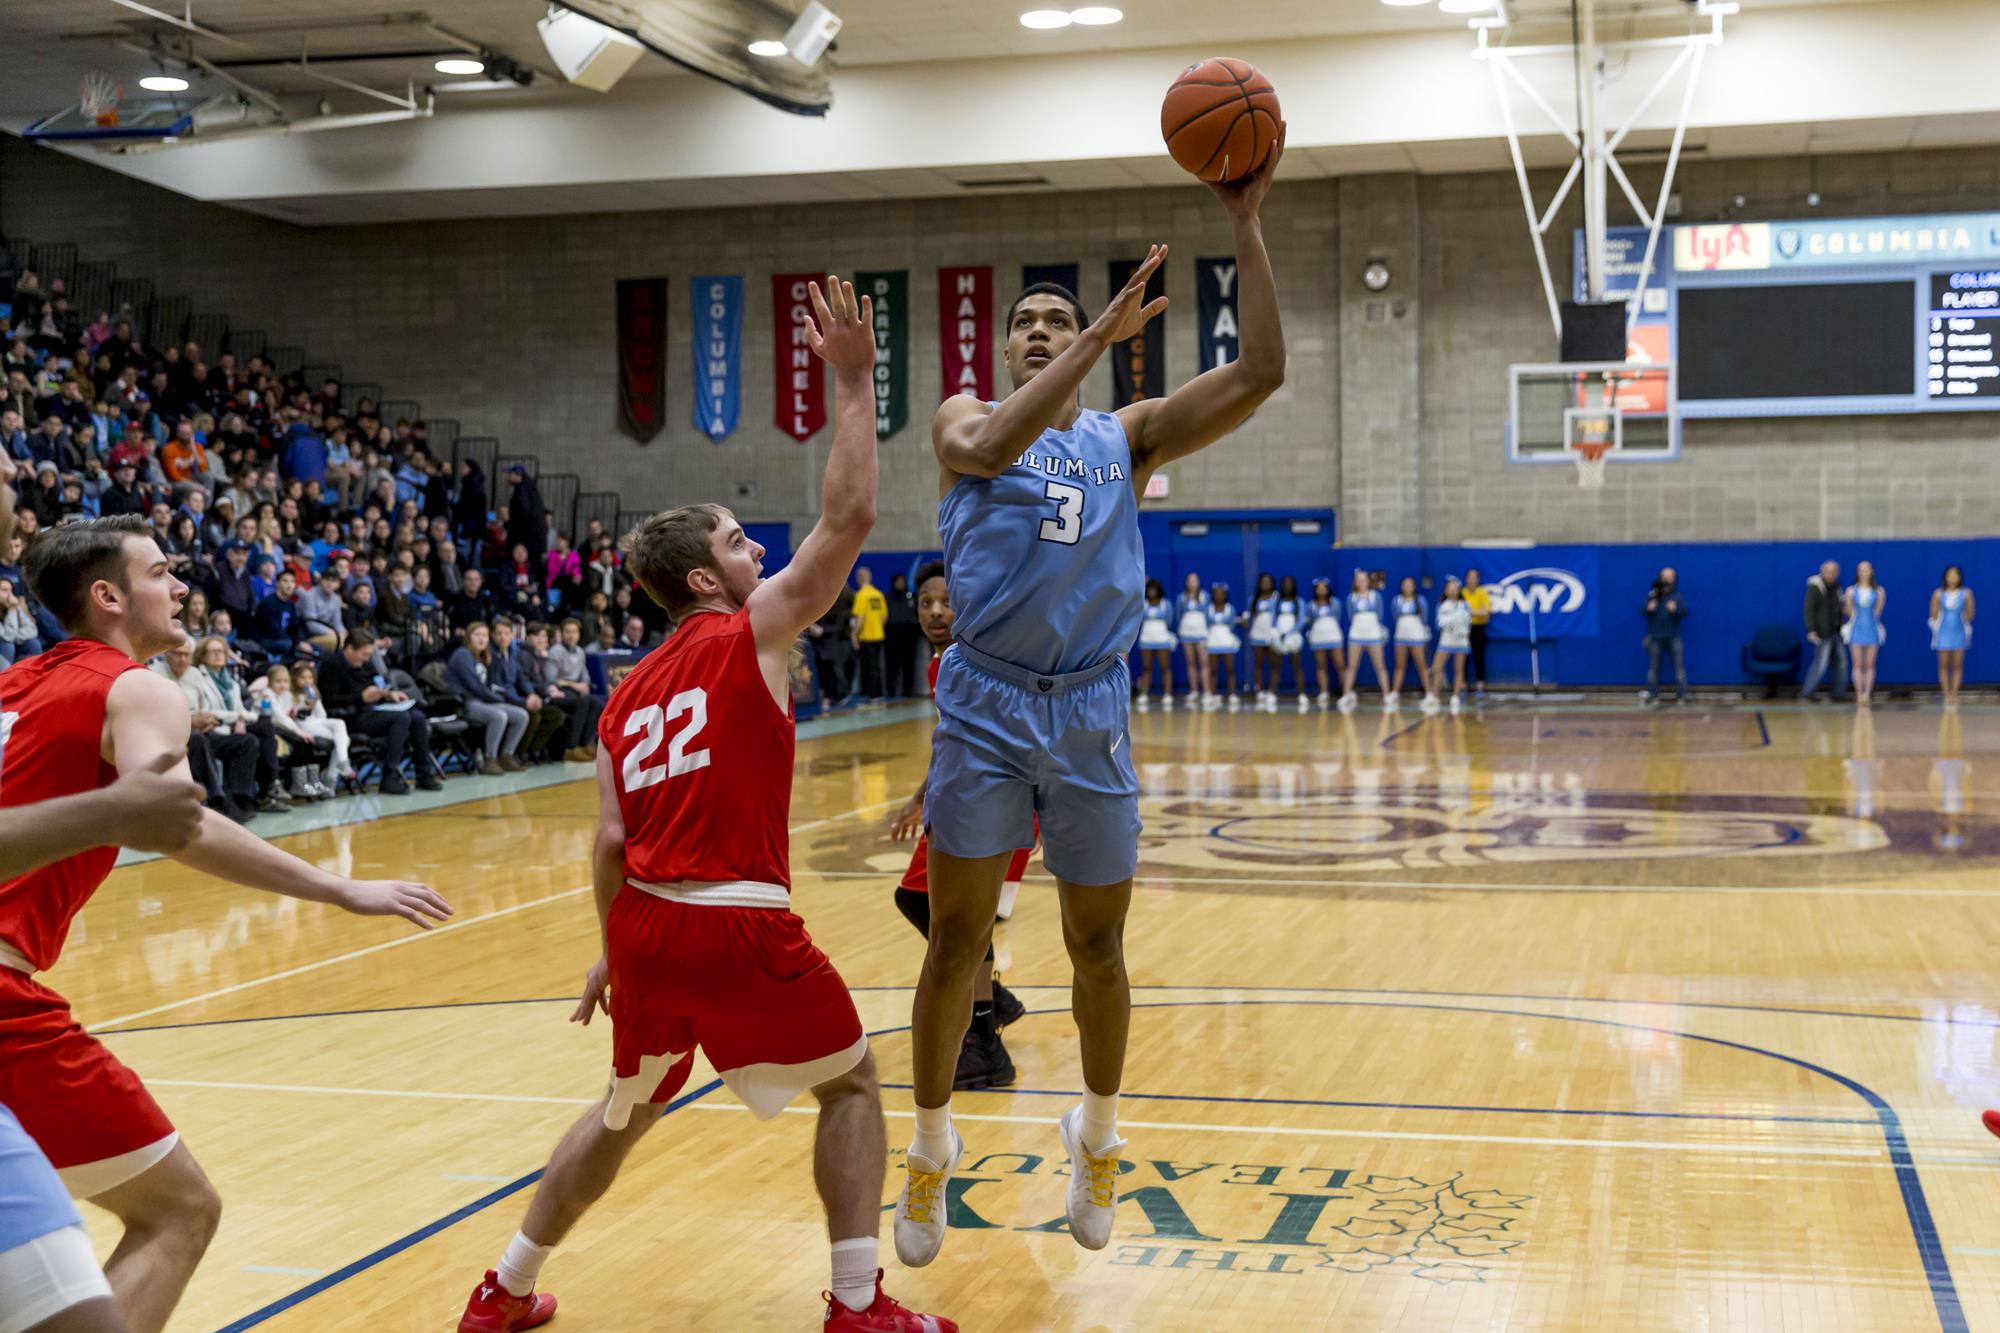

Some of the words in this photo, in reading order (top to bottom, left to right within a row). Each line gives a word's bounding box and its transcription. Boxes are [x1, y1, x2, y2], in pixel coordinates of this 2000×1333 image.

[1809, 227, 1971, 256] COLUMBIA
[708, 283, 727, 435] COLUMBIA
[790, 281, 809, 435] CORNELL
[873, 279, 891, 433] DARTMOUTH
[1037, 480, 1086, 546] 3
[621, 685, 712, 793] 22
[1106, 1244, 1304, 1275] THE
